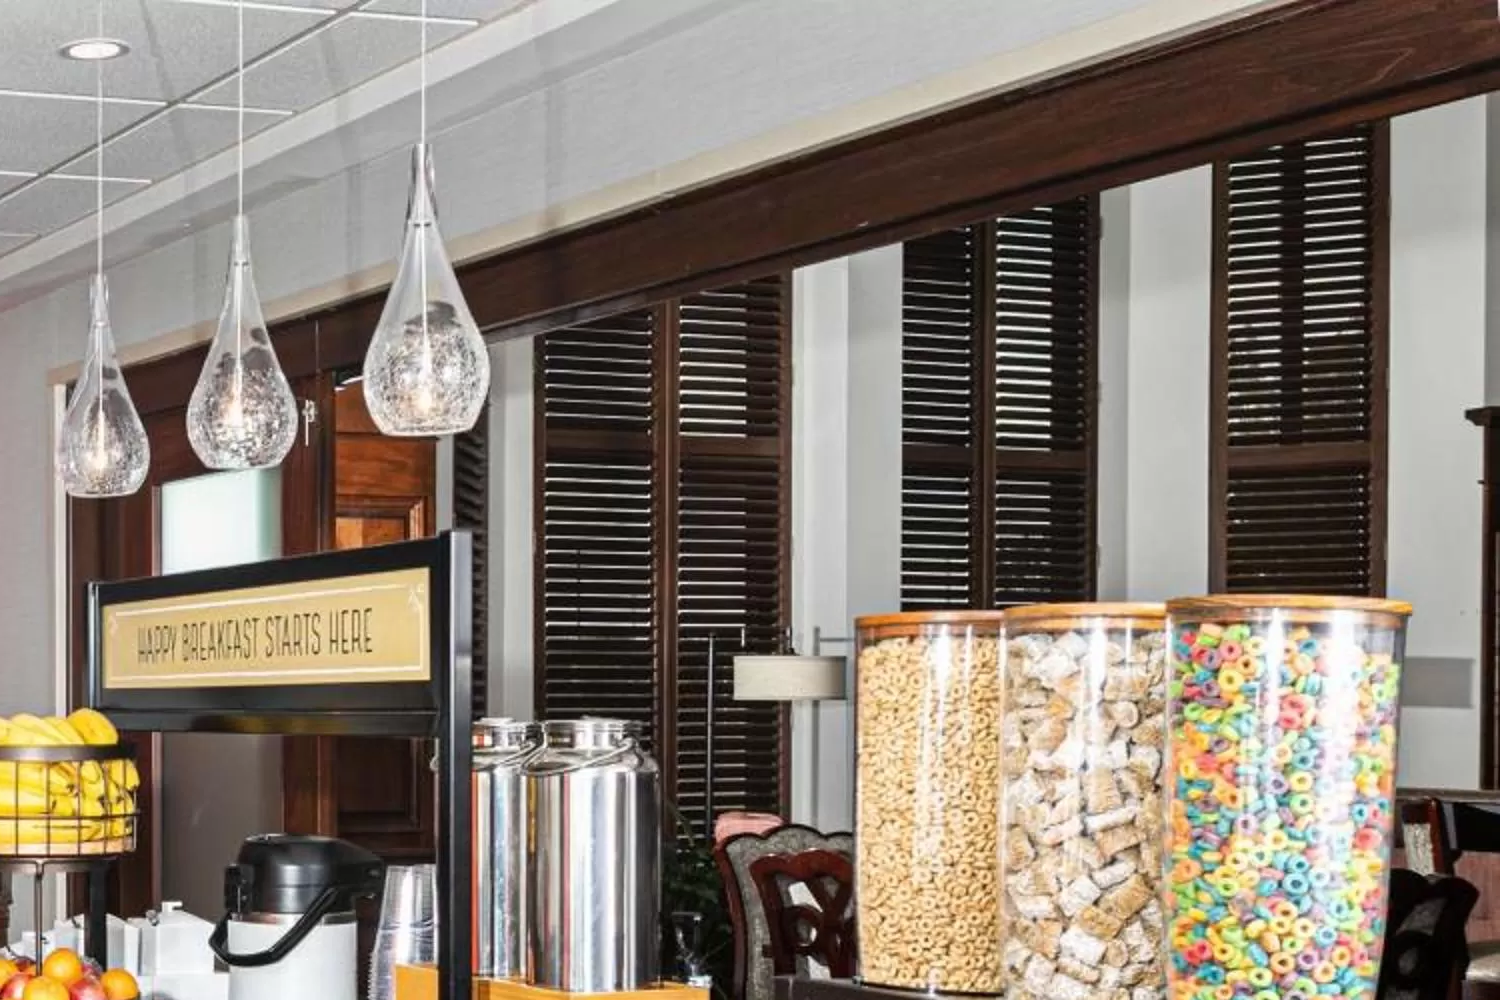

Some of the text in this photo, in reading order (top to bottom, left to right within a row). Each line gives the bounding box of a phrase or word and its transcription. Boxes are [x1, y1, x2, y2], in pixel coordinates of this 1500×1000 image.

[137, 608, 373, 664] HAPPY BREAKFAST STARTS HERE
